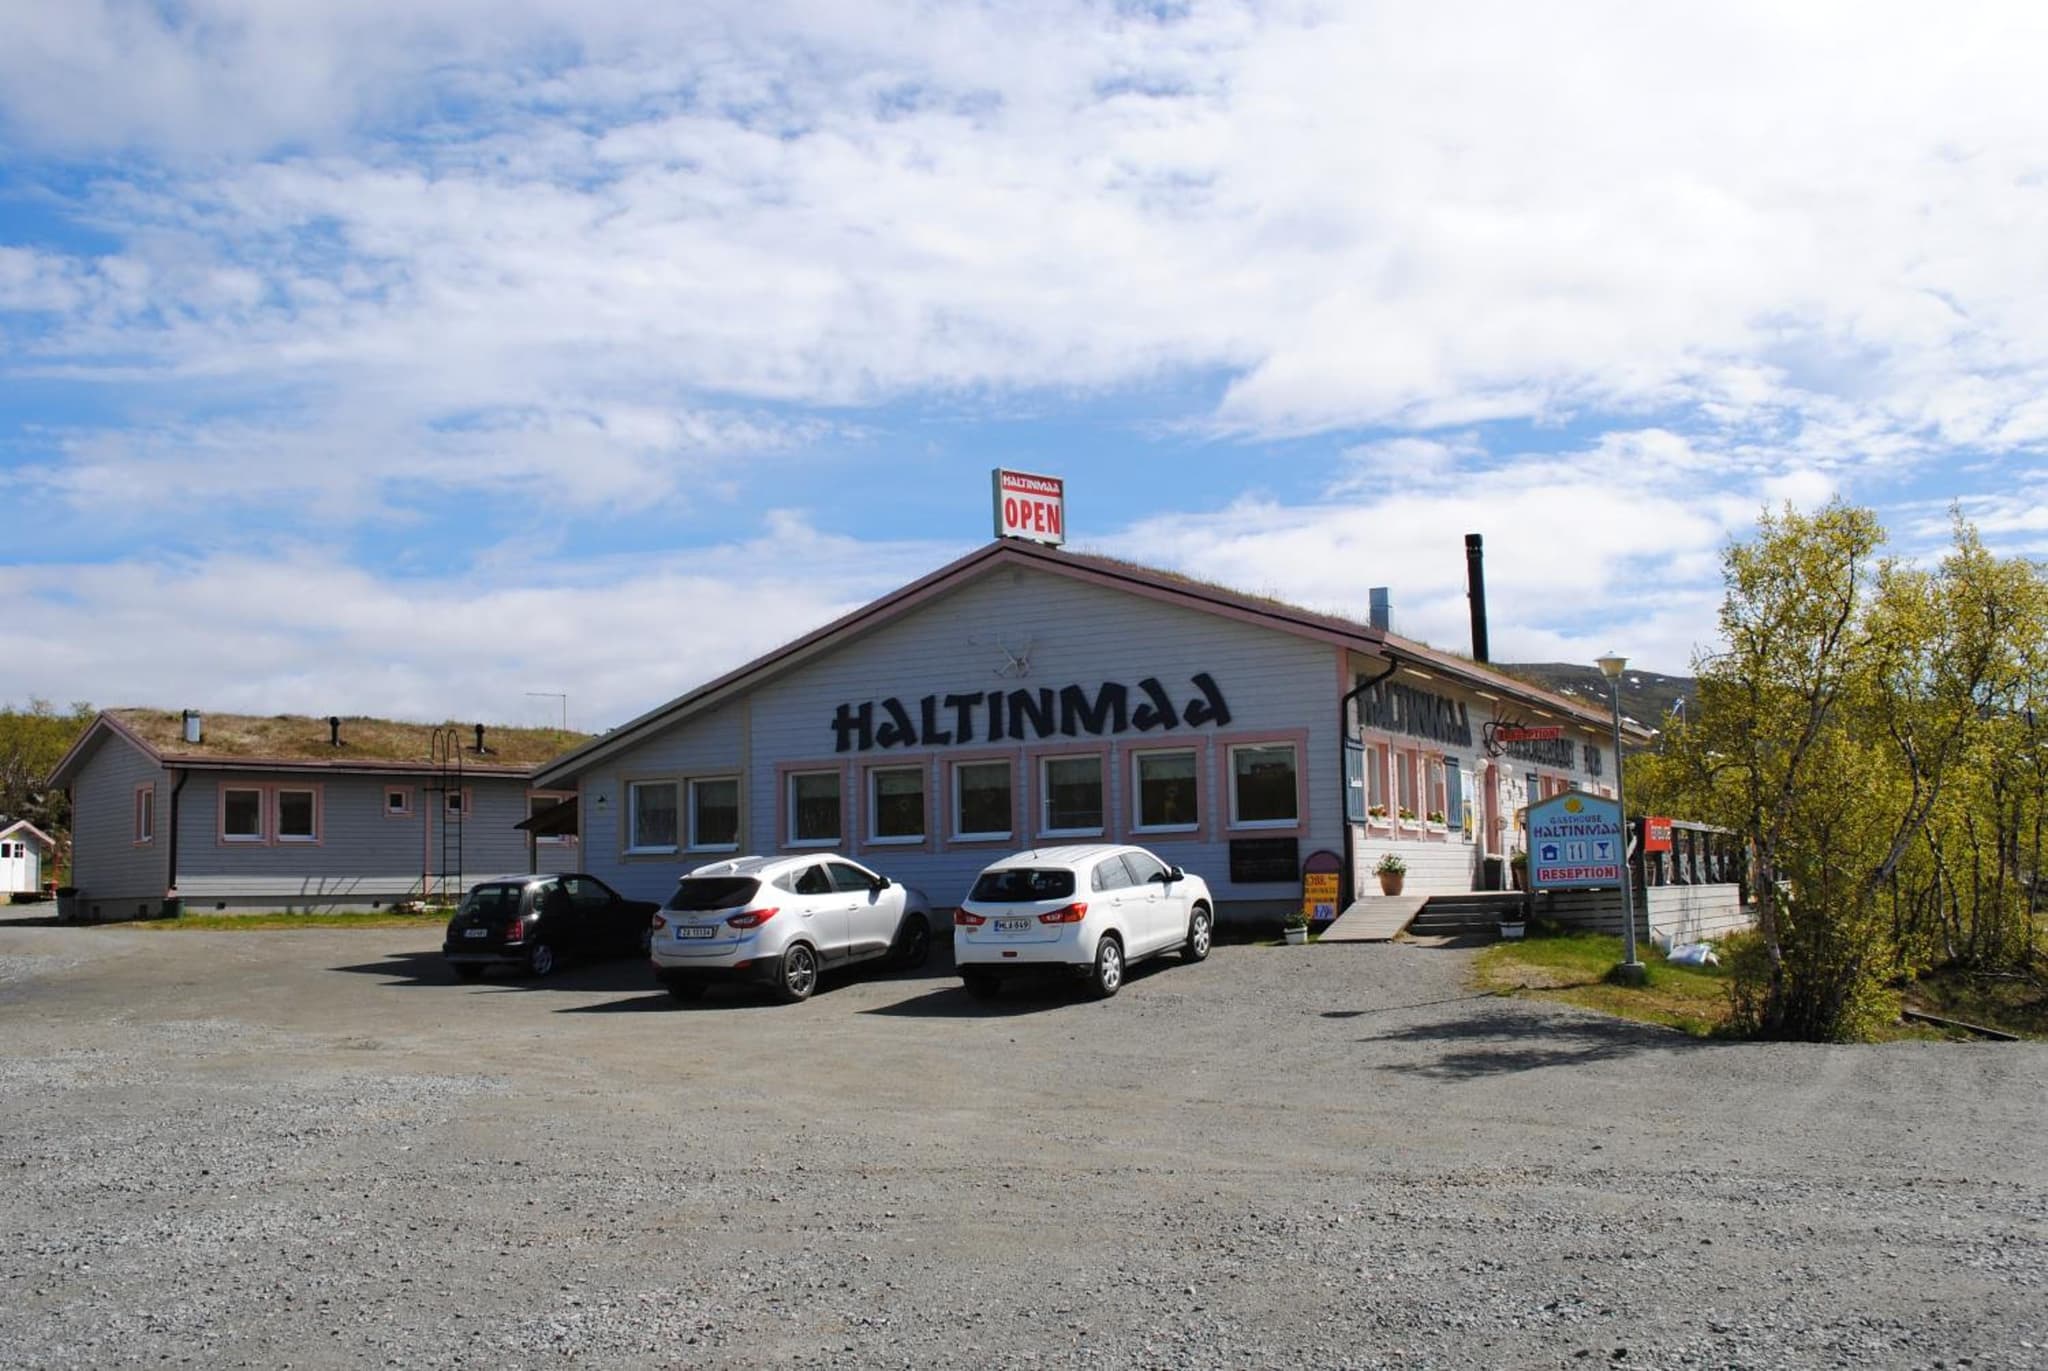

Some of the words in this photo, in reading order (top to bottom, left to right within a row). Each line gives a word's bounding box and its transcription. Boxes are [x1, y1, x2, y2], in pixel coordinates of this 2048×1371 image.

[1005, 497, 1060, 534] OPEN
[831, 672, 1231, 753] HALTINMAA
[1534, 823, 1621, 838] HALTINMAA
[1542, 867, 1613, 880] RESEPTION
